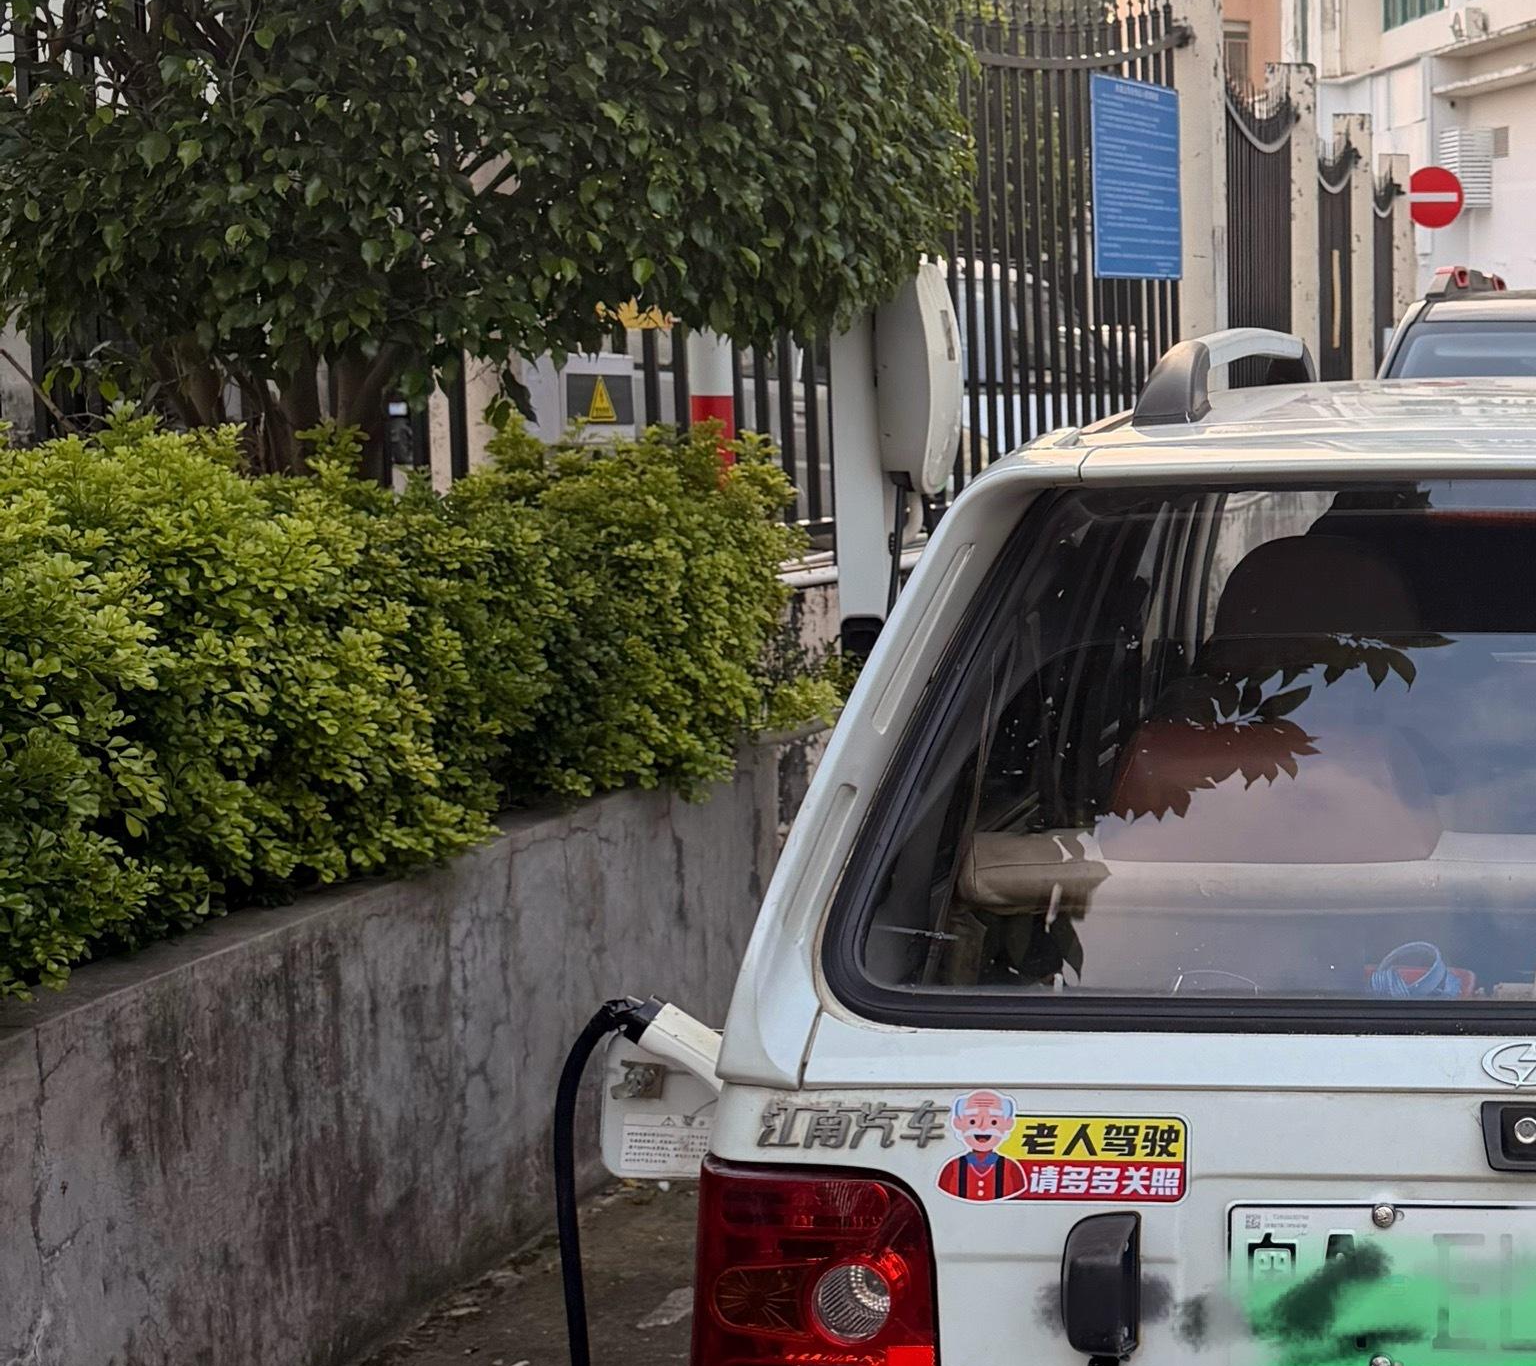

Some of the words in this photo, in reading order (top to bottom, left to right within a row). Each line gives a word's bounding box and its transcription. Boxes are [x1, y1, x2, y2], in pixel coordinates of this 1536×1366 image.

[756, 1099, 949, 1149] 江南汽车
[1021, 1123, 1181, 1157] 老人驾驶
[1029, 1166, 1181, 1196] 请多多关照
